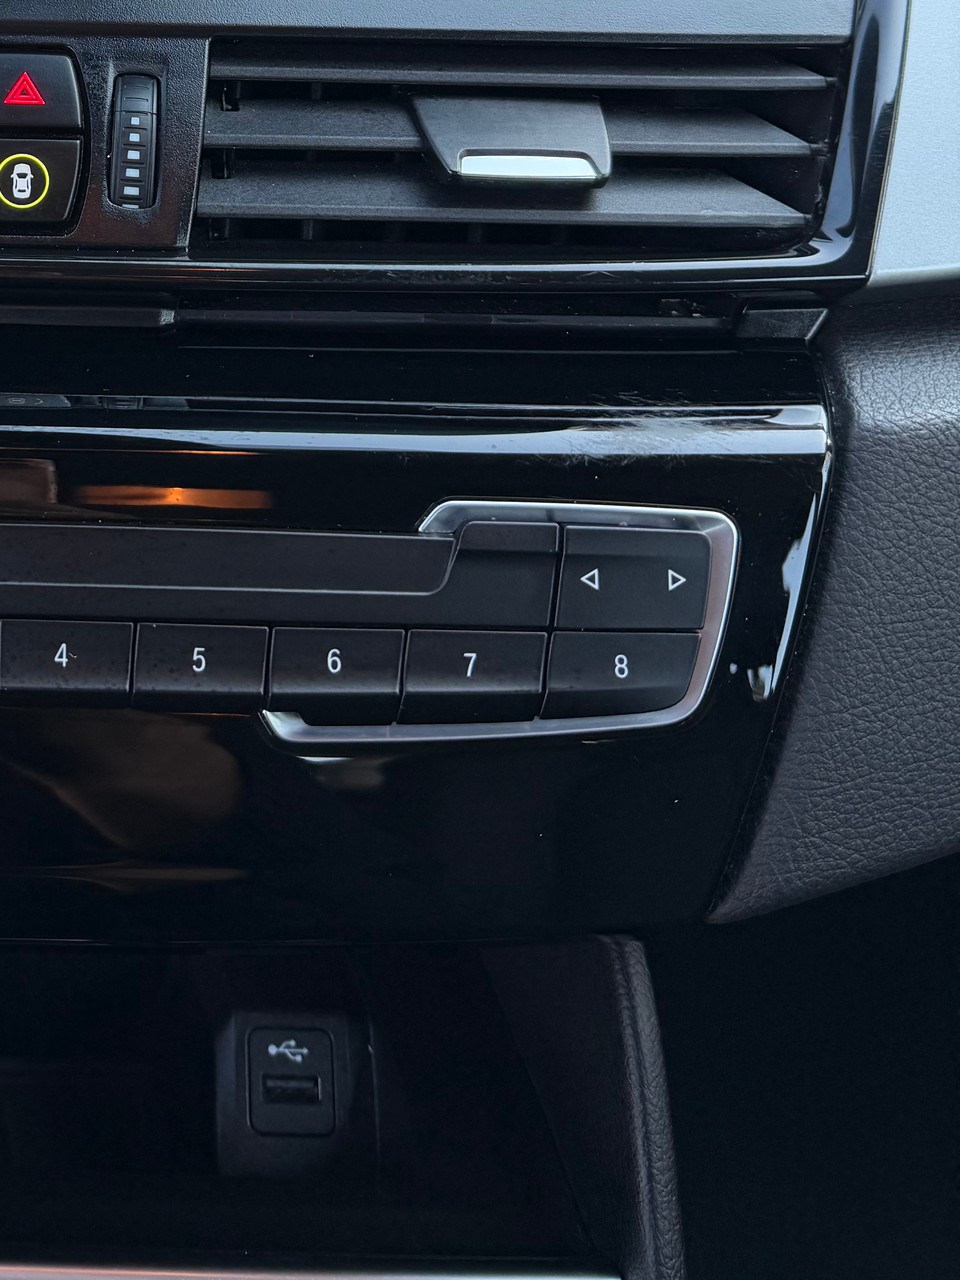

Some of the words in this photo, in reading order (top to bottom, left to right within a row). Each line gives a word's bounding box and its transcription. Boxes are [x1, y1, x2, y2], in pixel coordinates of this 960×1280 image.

[53, 643, 69, 668] 4
[192, 648, 207, 673] 5
[327, 649, 342, 675] 6
[462, 653, 478, 677] 7
[614, 655, 629, 680] 8
